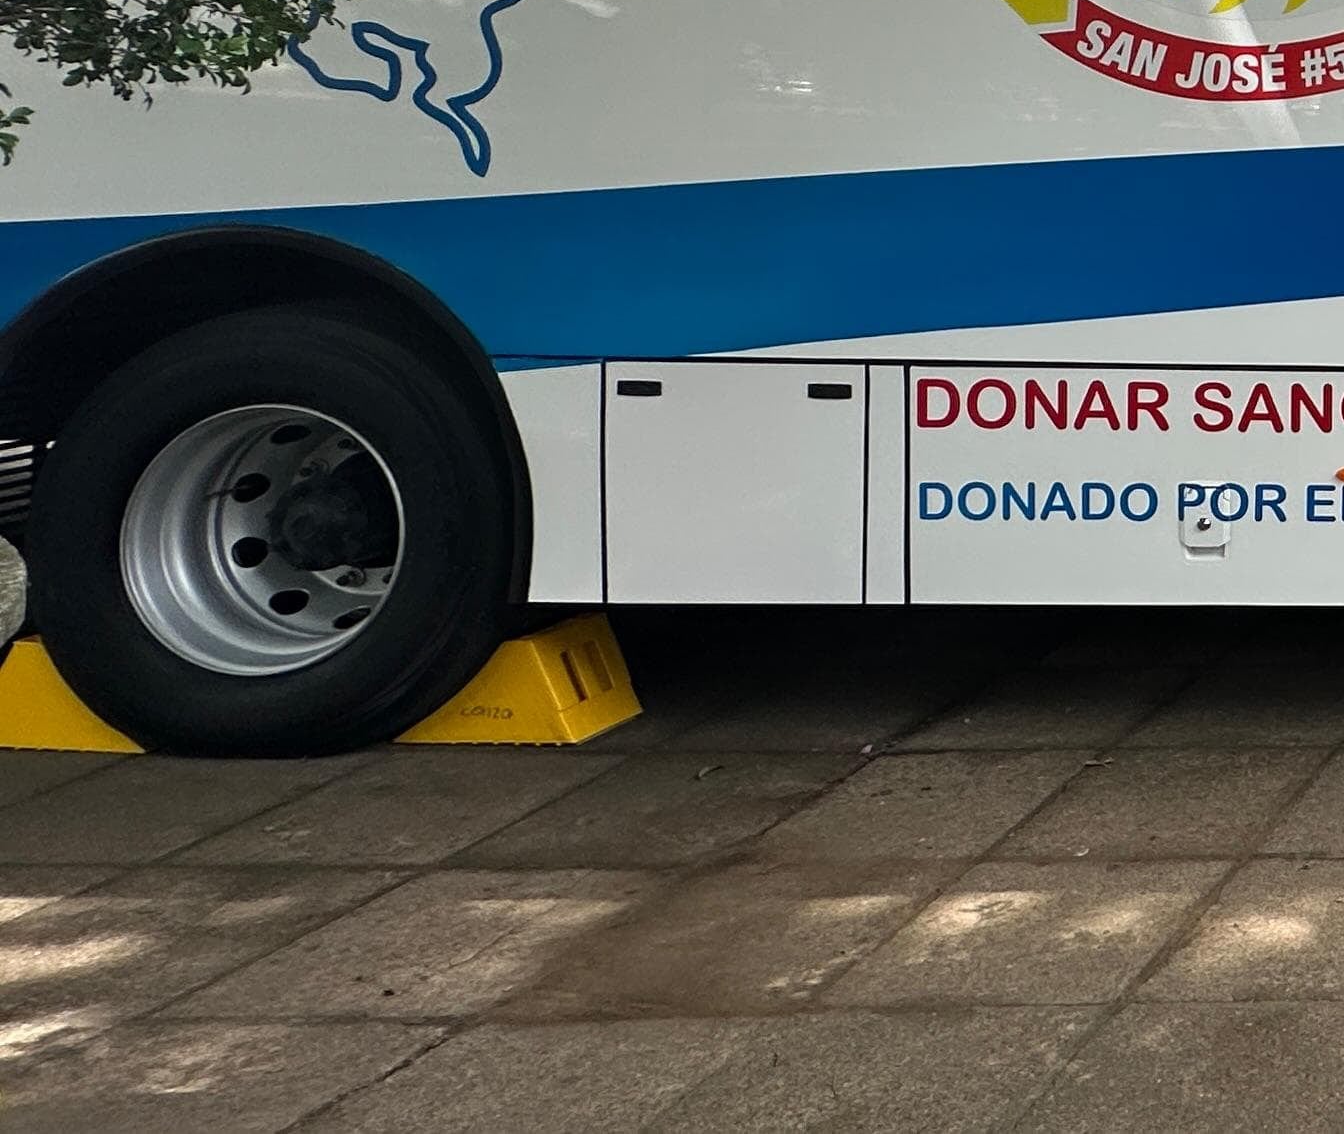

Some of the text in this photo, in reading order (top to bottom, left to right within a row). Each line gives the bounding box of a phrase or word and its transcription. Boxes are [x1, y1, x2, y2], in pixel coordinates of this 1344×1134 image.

[1076, 19, 1168, 82] SAN
[1175, 44, 1287, 93] JOSÉ
[916, 378, 1170, 432] DONAR
[919, 481, 1159, 522] DONADO
[1178, 483, 1287, 523] POR
